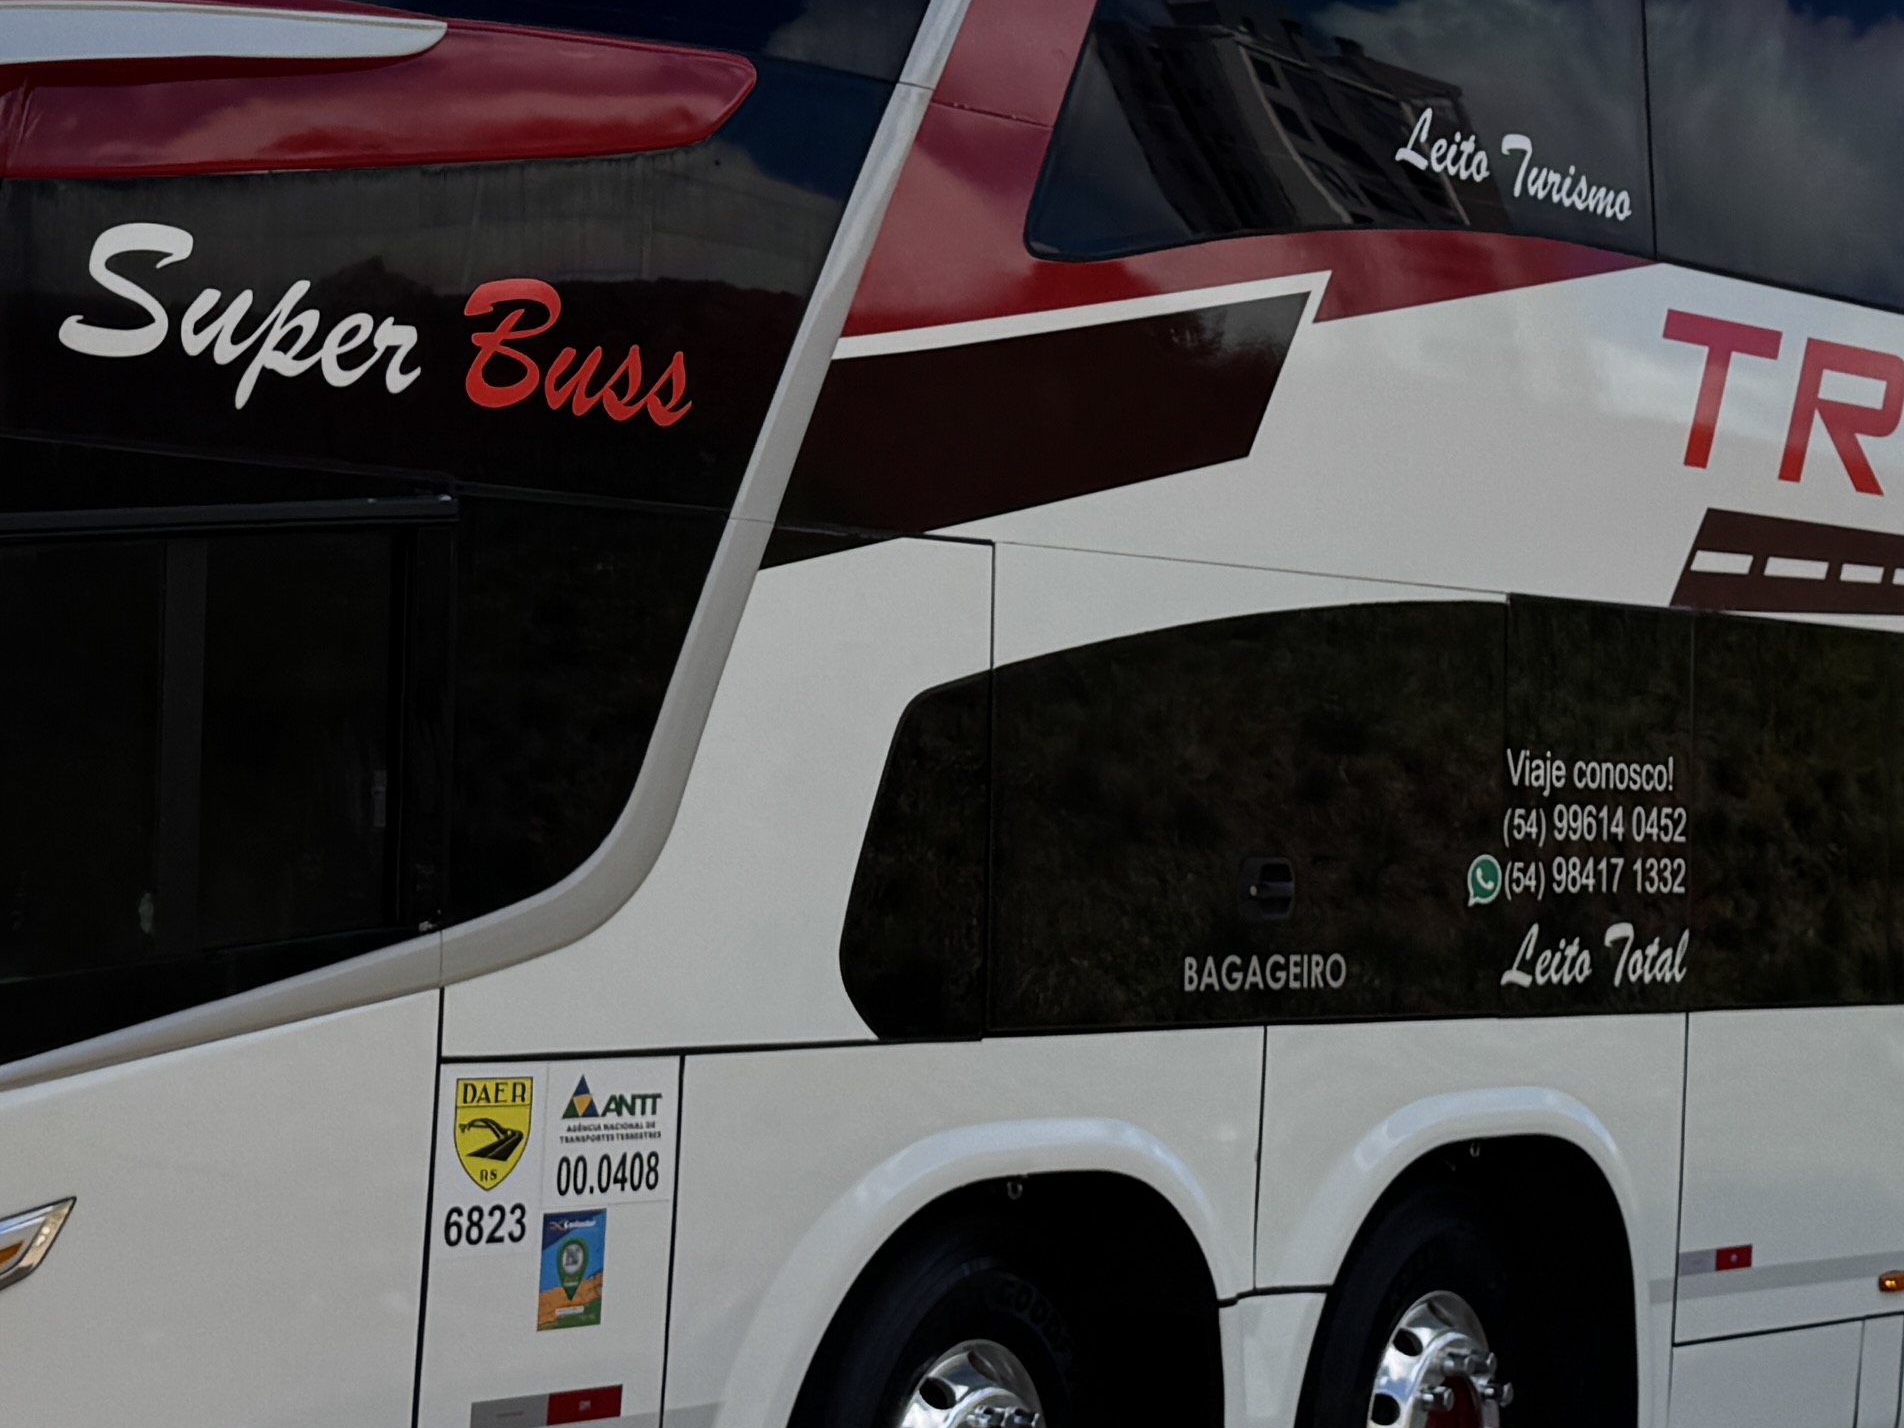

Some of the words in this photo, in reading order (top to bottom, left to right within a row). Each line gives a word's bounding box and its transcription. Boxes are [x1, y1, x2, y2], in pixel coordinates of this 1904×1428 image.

[1395, 107, 1490, 183] Leito
[1501, 133, 1632, 222] Turismo
[58, 222, 422, 410] Super
[464, 277, 692, 427] Buss
[1506, 748, 1566, 797] Viaje
[1573, 756, 1675, 792] conosco!
[1503, 807, 1546, 847] (54)
[1553, 804, 1625, 843] 99614
[1632, 807, 1687, 843] 0452
[1504, 860, 1546, 900] (54)
[1552, 857, 1625, 894] 98417
[1633, 858, 1686, 894] 1332
[1183, 953, 1347, 992] BAGAGEIRO
[1500, 922, 1592, 988] Leito
[1604, 922, 1690, 988] Total
[462, 1081, 527, 1104] DAER
[600, 1092, 663, 1118] ANTT
[479, 1169, 498, 1182] RS
[556, 1151, 660, 1196] 00.0408
[443, 1202, 527, 1247] 6823
